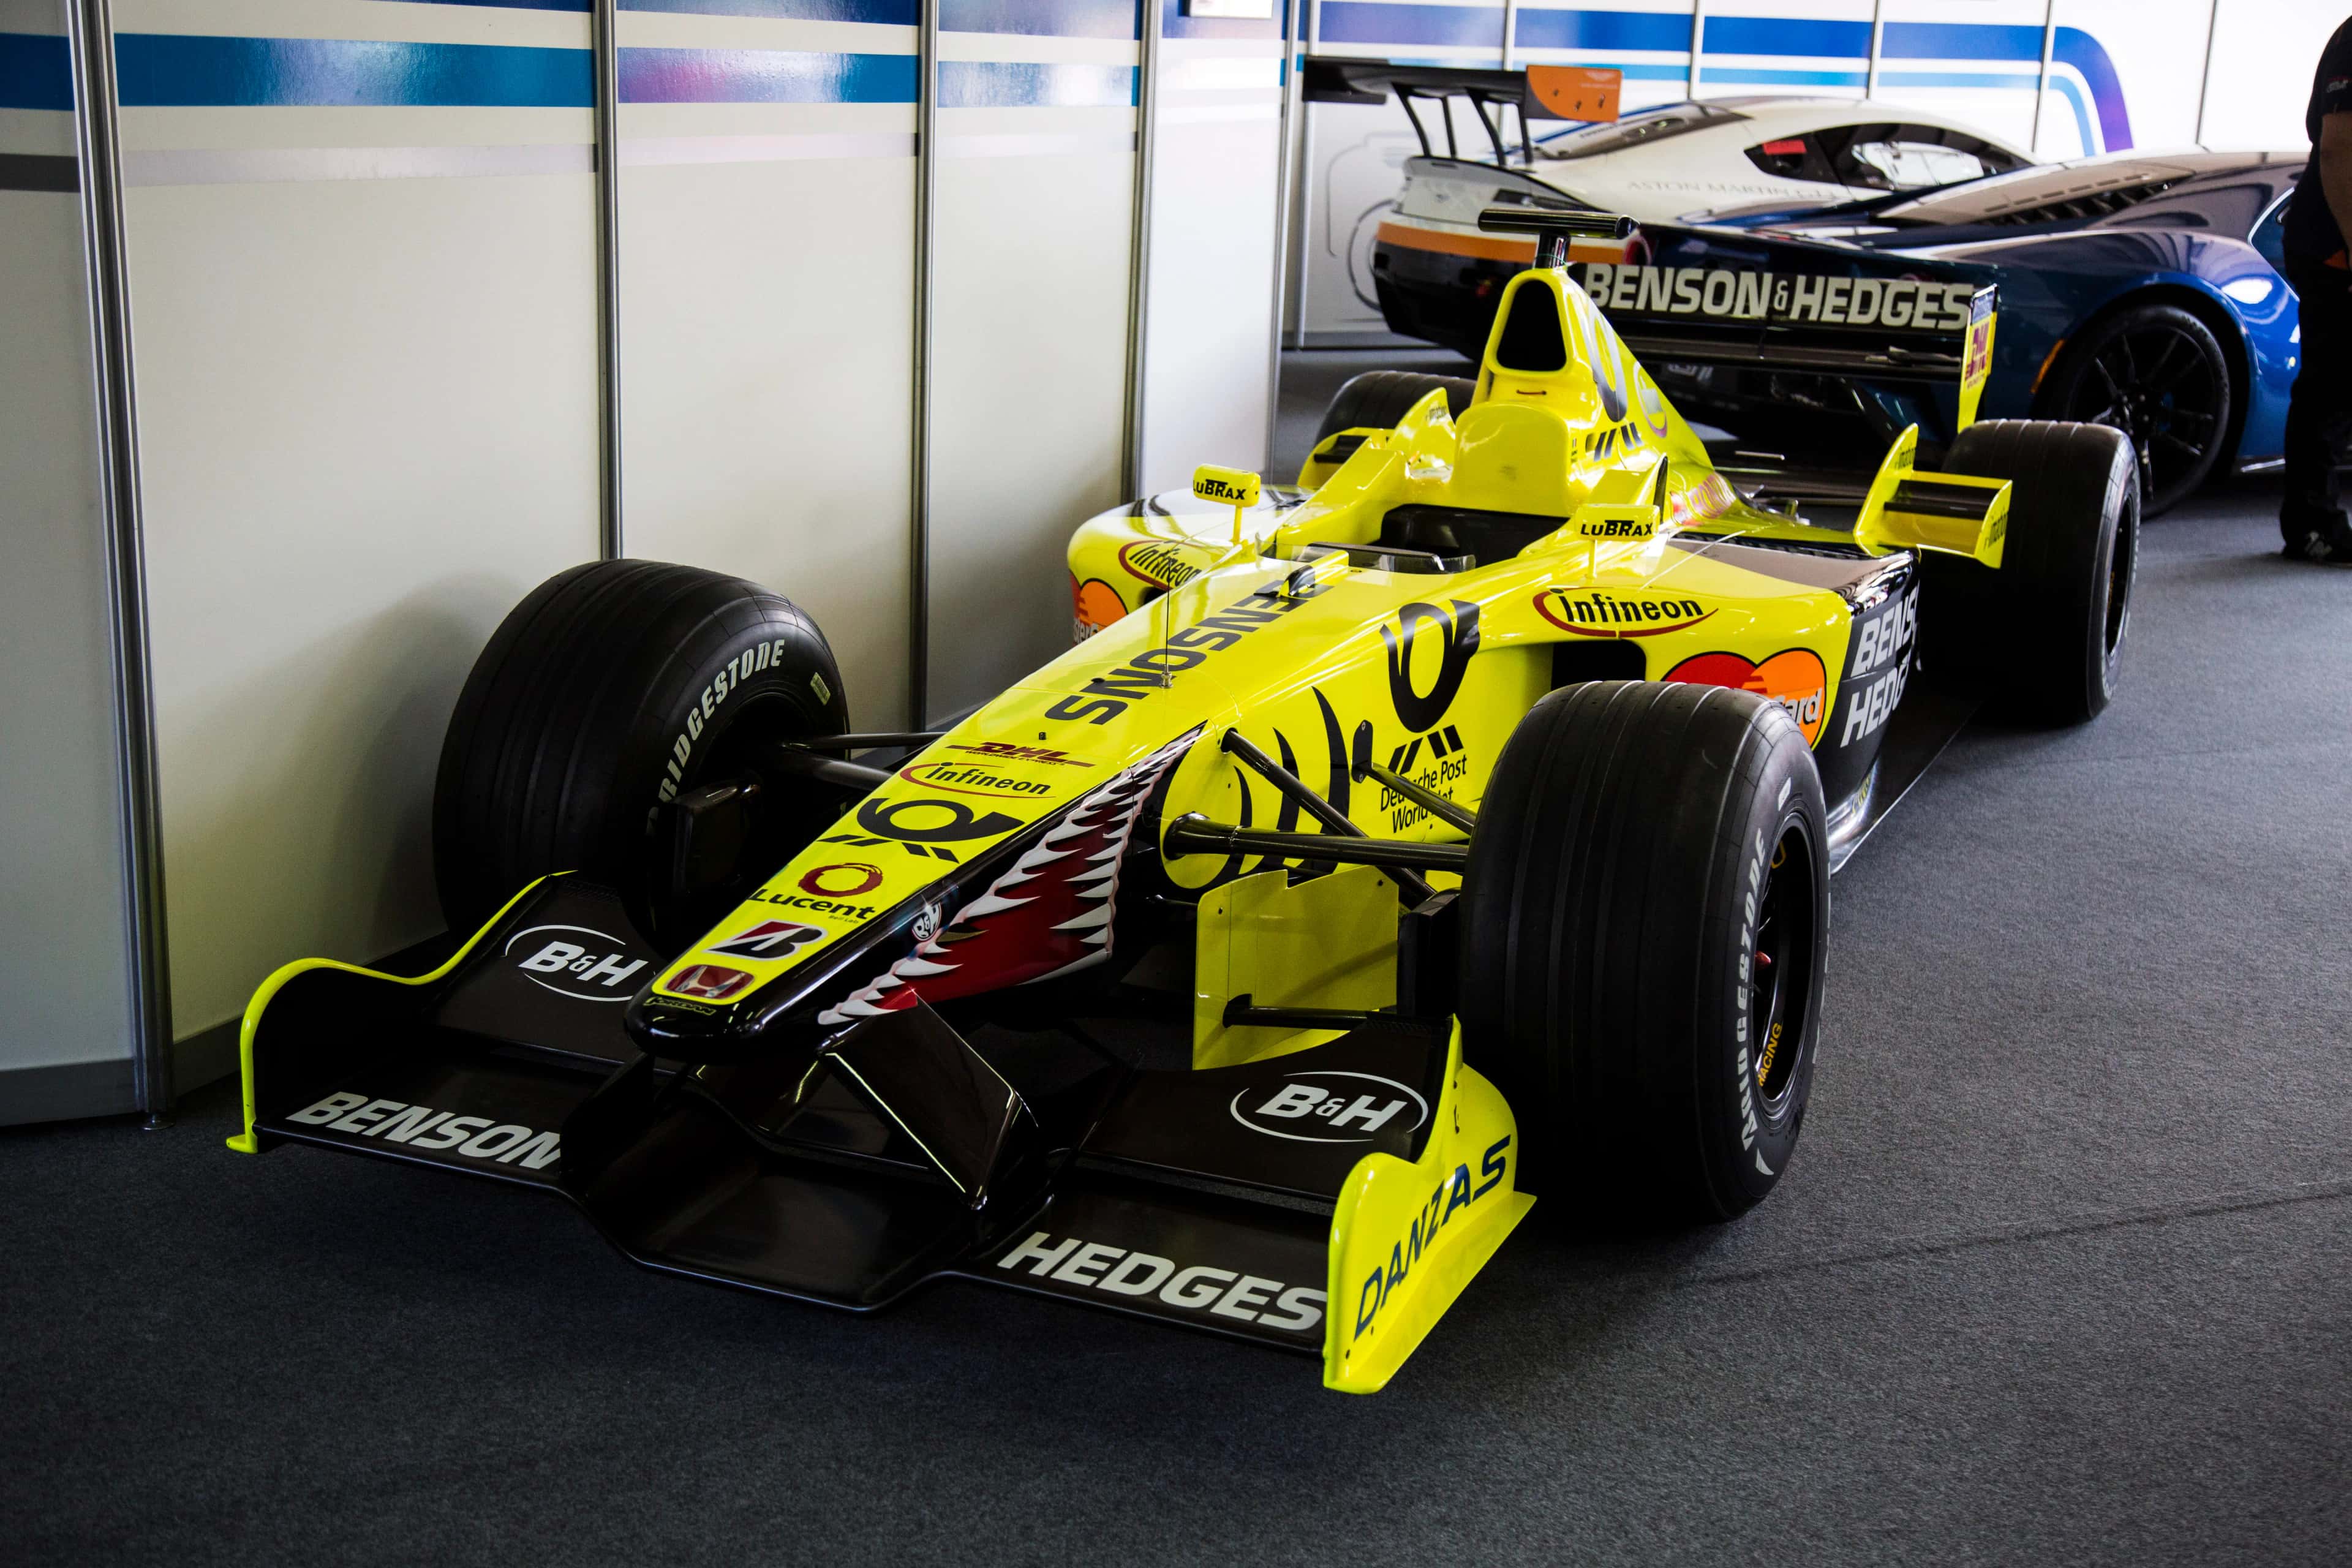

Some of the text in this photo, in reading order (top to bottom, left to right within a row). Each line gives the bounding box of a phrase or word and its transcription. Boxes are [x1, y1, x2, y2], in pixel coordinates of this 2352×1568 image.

[1583, 263, 1773, 317] BENSON
[1774, 279, 1788, 311] &
[1789, 275, 1973, 330] HEDGES
[1850, 585, 1918, 677] BENS
[1840, 662, 1908, 748] HEDG
[971, 742, 1070, 763] DHL
[1441, 755, 1468, 784] Post
[747, 889, 876, 919] Lucent
[518, 941, 649, 986] B&H
[1737, 827, 1765, 1152] BRIDGESTONE
[285, 1091, 561, 1170] BENSON
[1254, 1084, 1408, 1133] B&H
[1354, 1134, 1511, 1342] DANZAS
[997, 1231, 1329, 1331] HEDGES
